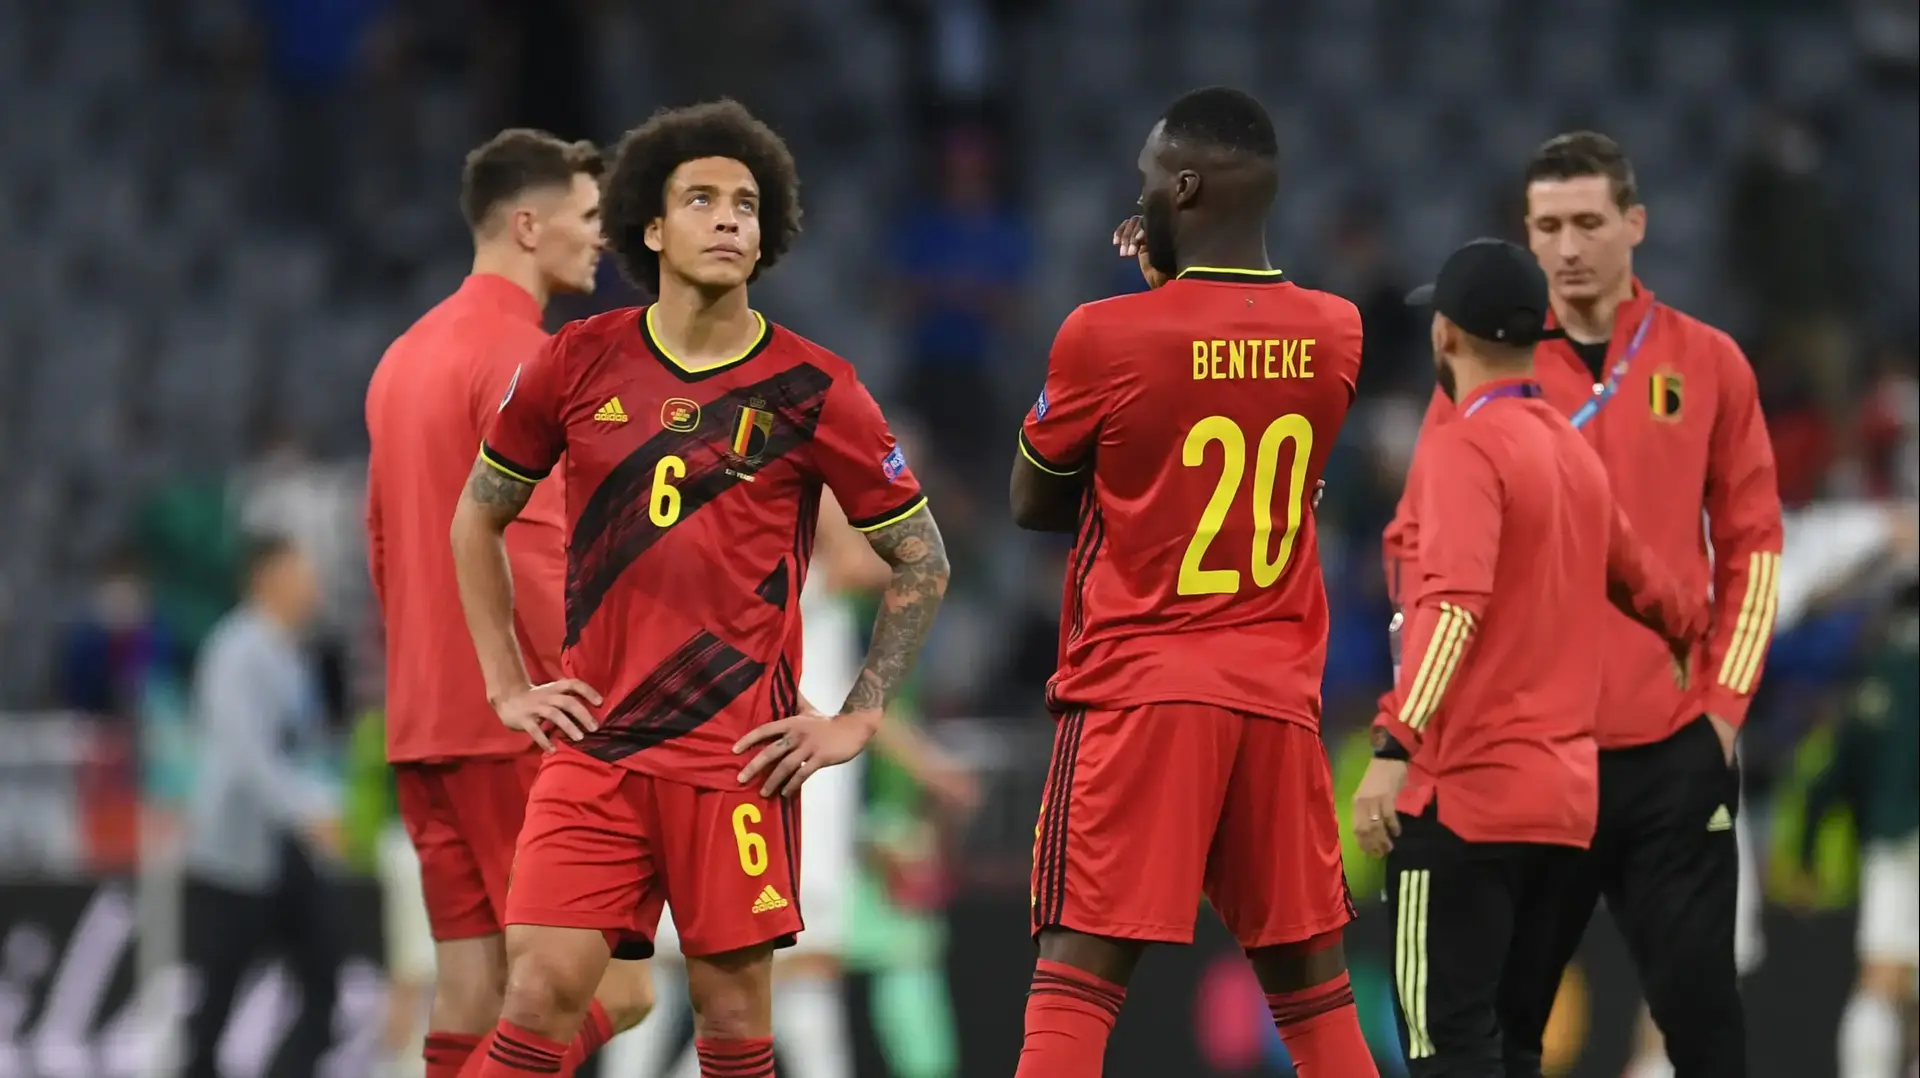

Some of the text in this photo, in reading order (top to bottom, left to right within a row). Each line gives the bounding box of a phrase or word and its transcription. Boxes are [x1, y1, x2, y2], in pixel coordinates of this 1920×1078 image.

[1192, 339, 1316, 380] BENTEKE
[594, 412, 629, 422] adidas
[649, 455, 686, 527] 6
[1177, 413, 1313, 595] 20
[732, 803, 768, 876] 6
[752, 898, 788, 914] adidas
